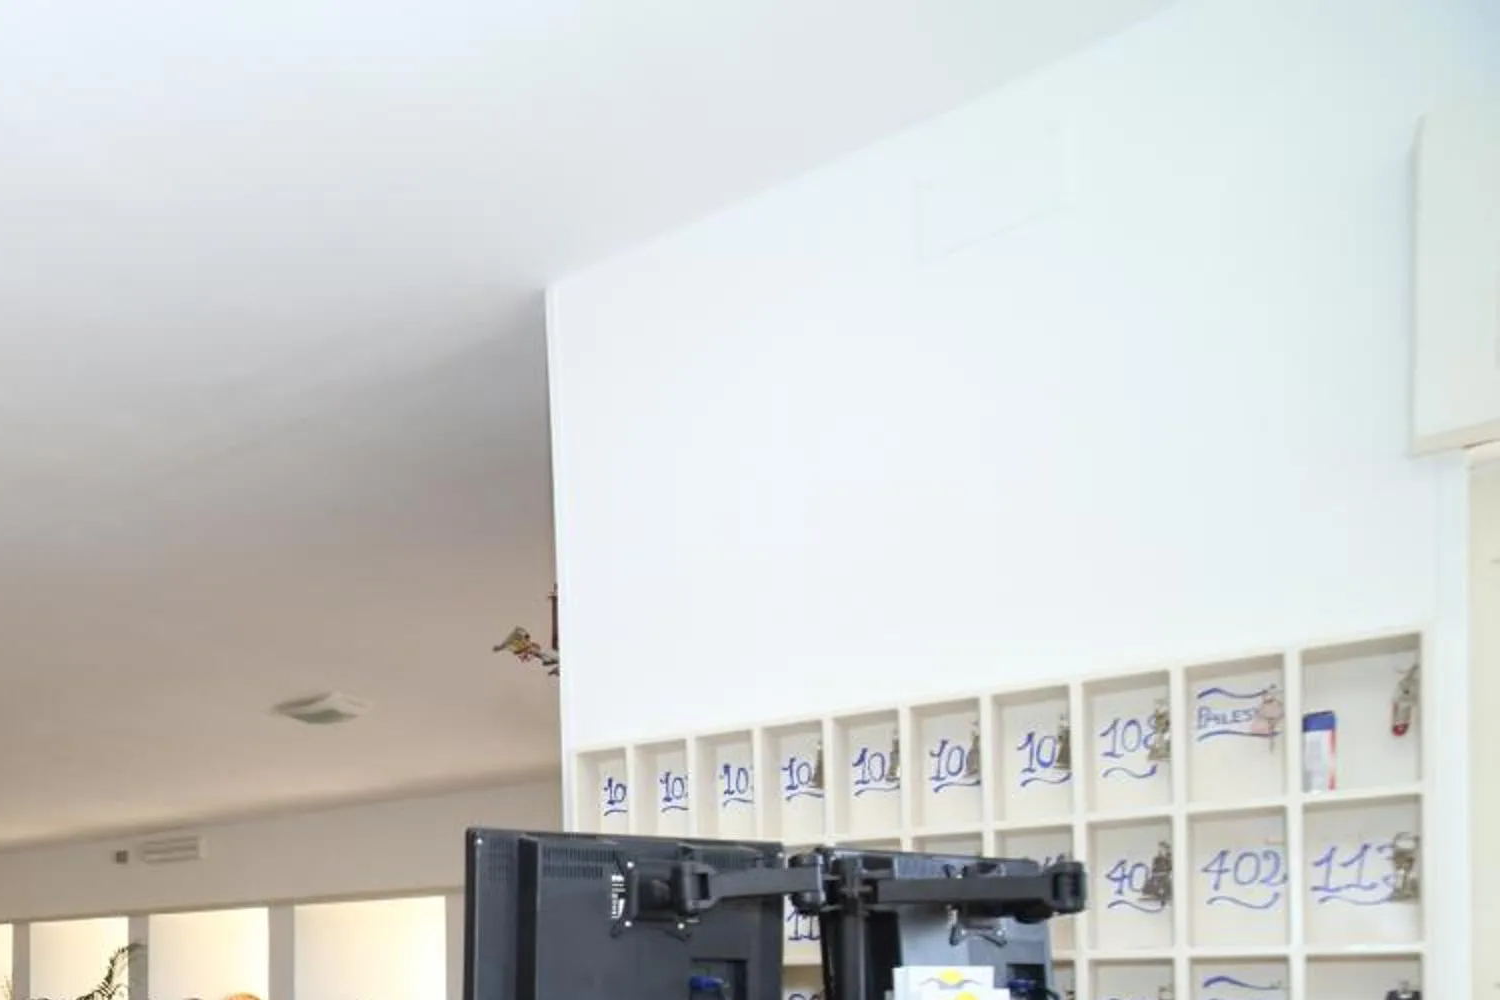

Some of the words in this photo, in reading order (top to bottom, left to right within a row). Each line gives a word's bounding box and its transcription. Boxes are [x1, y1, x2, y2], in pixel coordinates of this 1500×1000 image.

[852, 747, 890, 785] 10
[929, 739, 973, 781] 10
[1017, 731, 1058, 773] 10
[660, 771, 688, 802] 10
[719, 763, 753, 795] 10
[781, 757, 814, 791] 10
[1105, 859, 1151, 895] 40
[1201, 849, 1290, 892] 402
